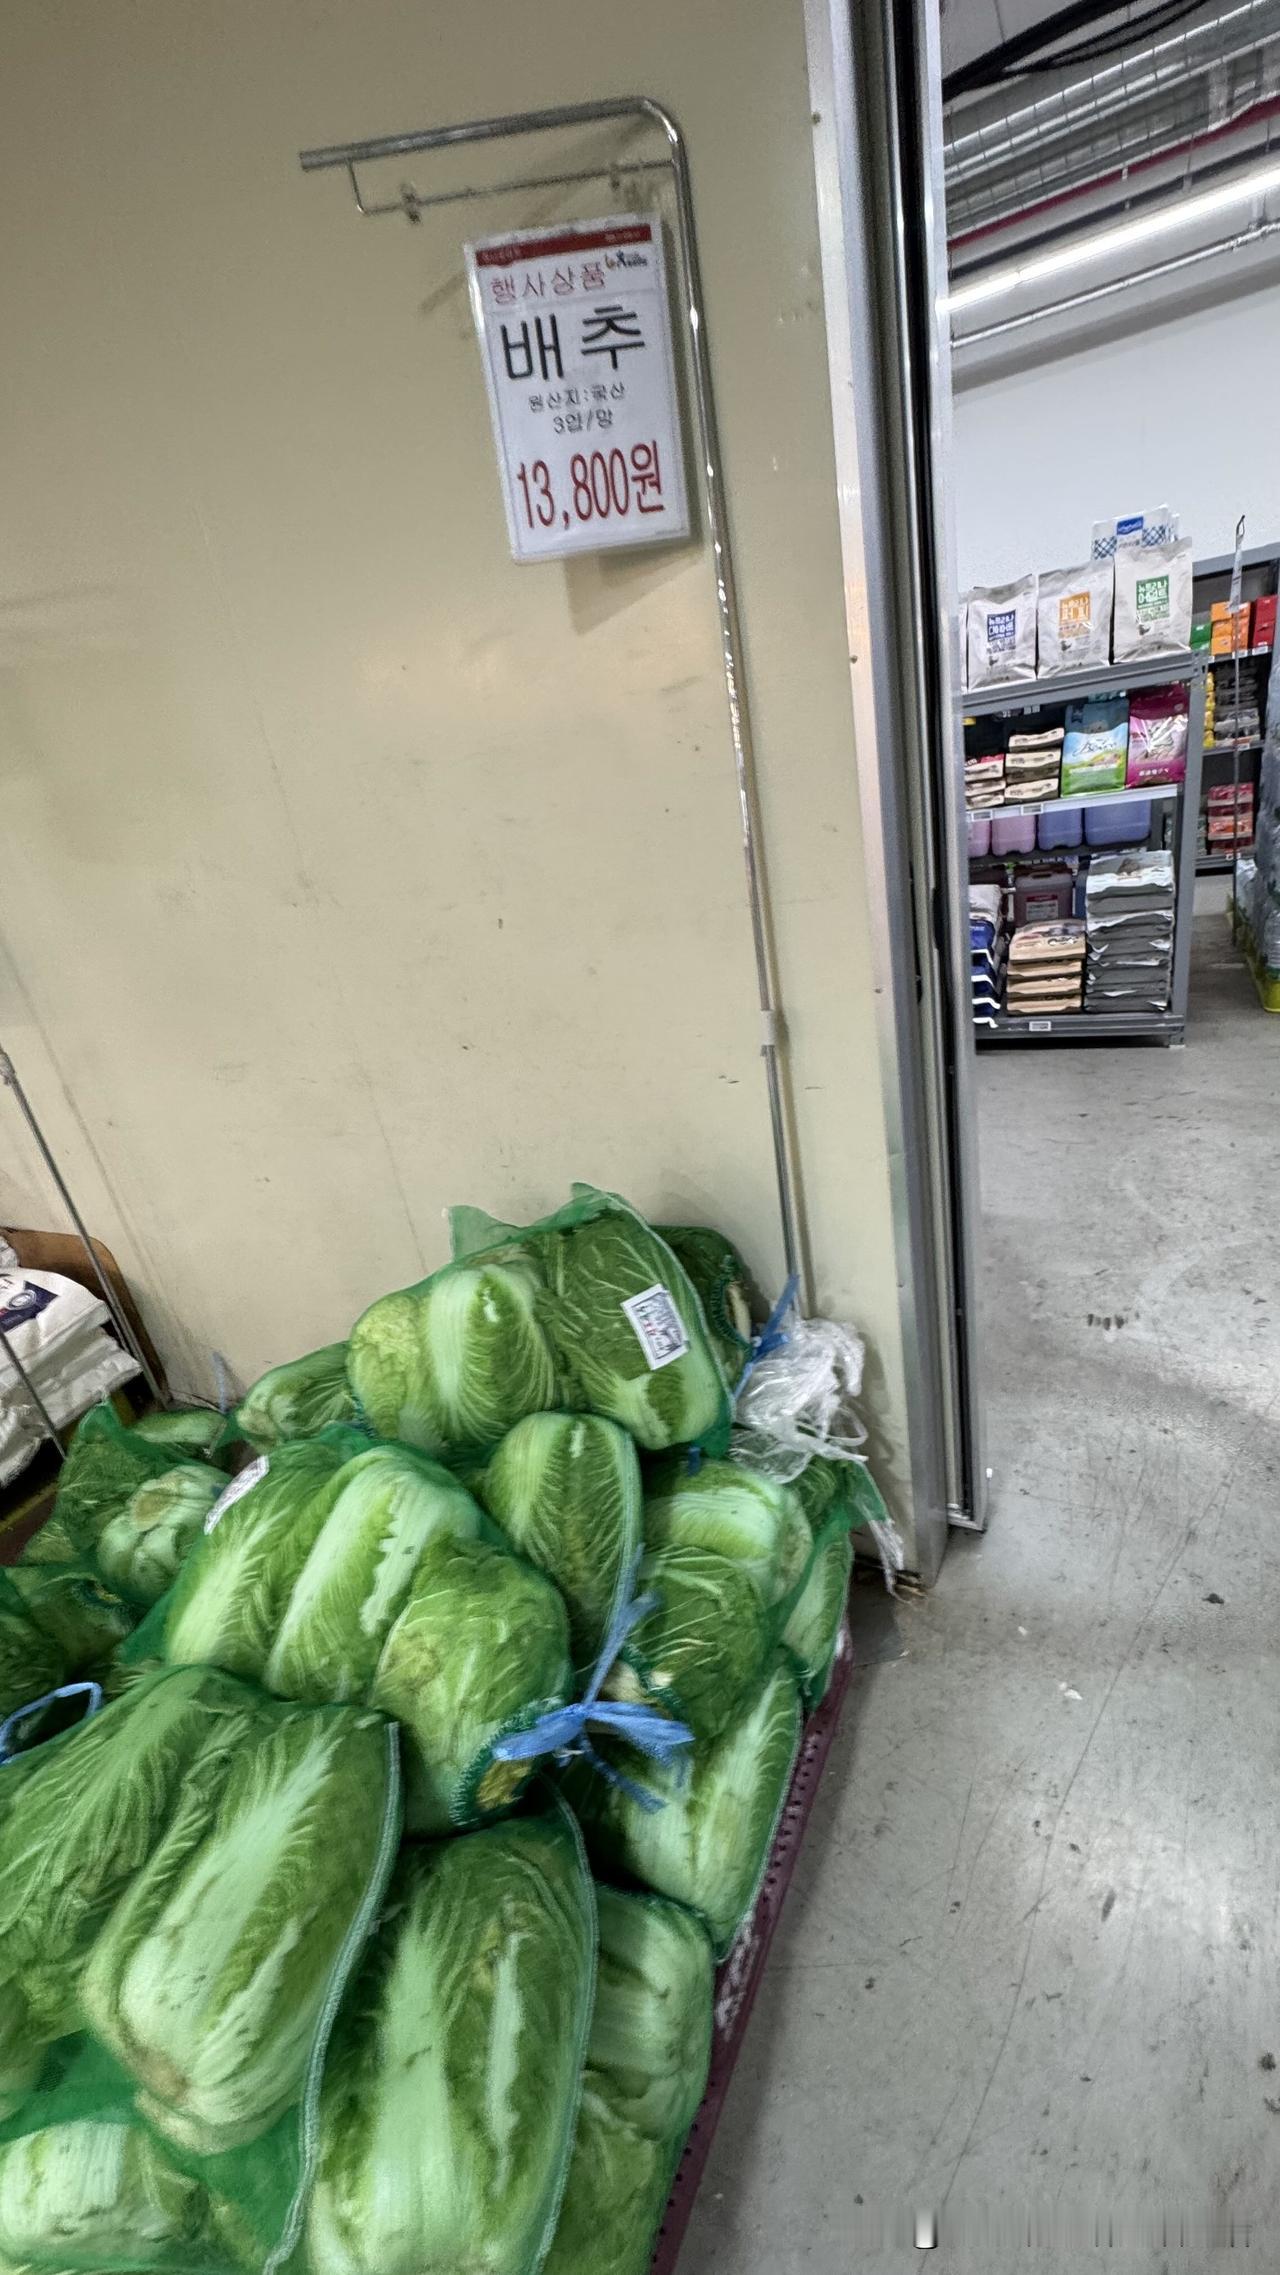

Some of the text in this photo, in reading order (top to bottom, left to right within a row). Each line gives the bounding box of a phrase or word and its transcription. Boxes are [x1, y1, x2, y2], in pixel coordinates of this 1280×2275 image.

[490, 261, 605, 305] 행사상품
[500, 304, 646, 381] 배추
[517, 440, 665, 530] 13,800원
